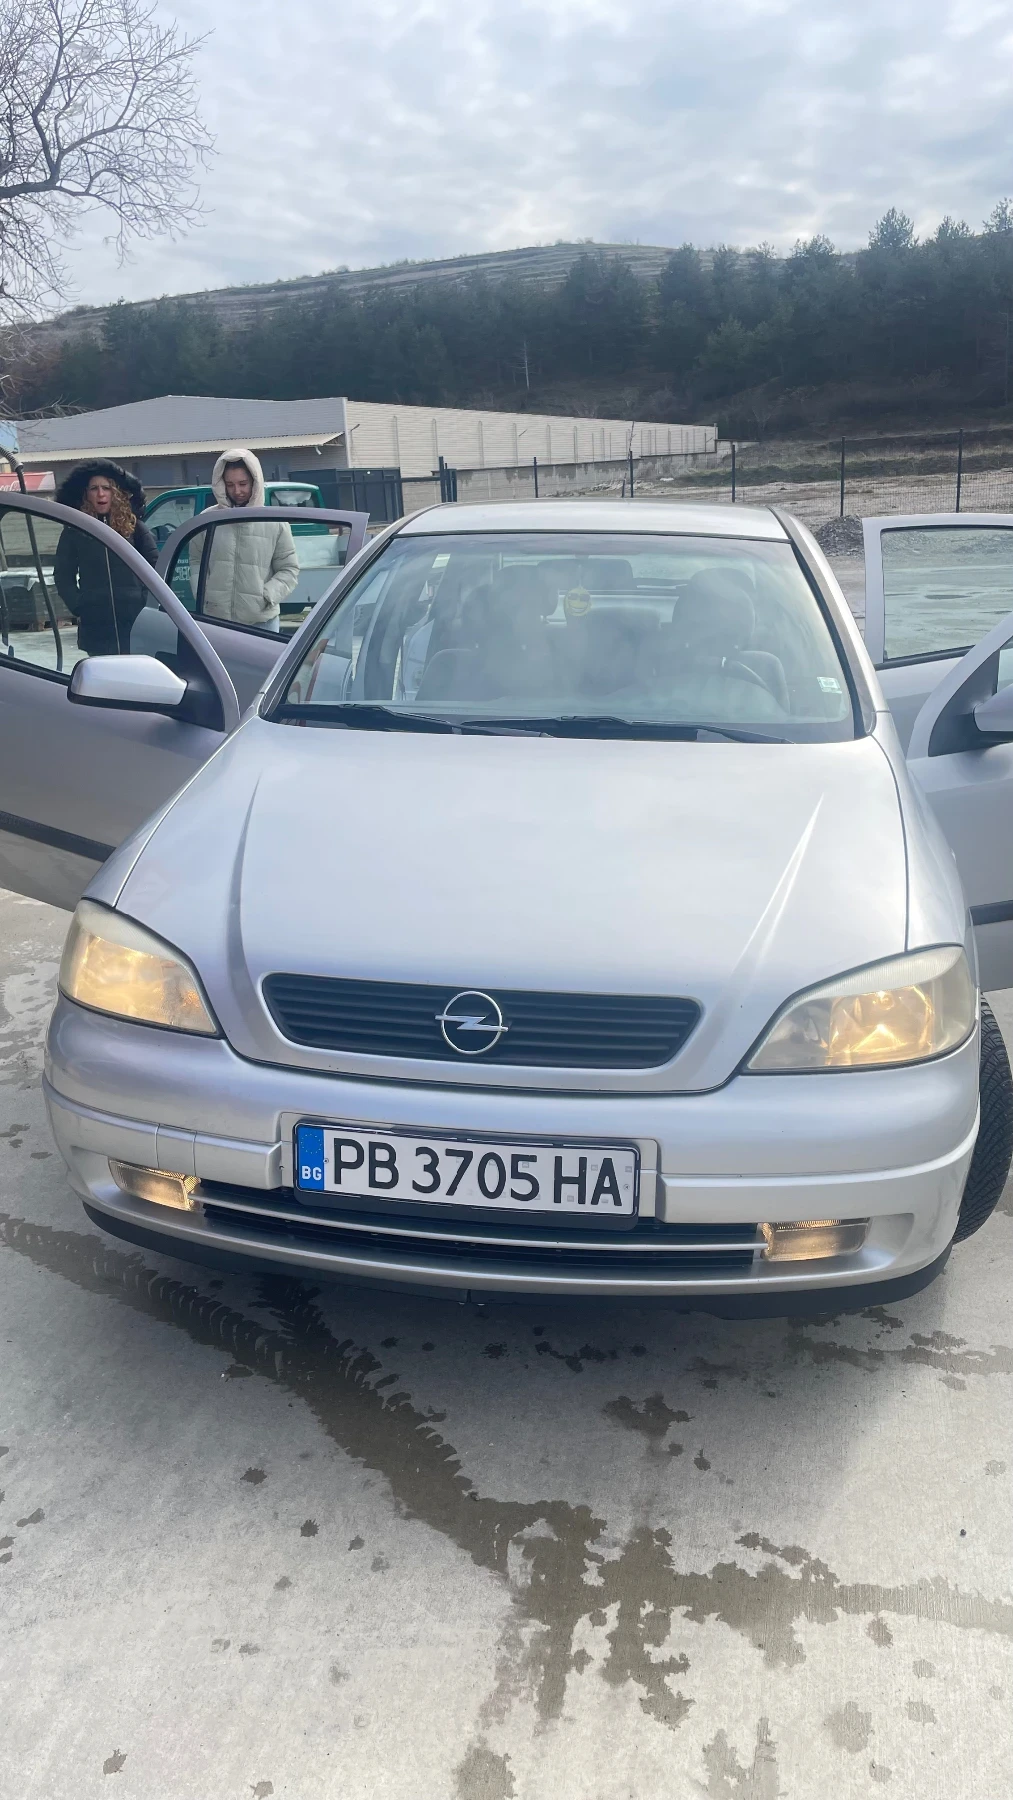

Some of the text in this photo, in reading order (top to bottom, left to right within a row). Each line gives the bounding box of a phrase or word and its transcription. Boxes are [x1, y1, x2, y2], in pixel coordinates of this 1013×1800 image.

[301, 1165, 322, 1181] BG
[333, 1137, 623, 1207] PB 3705 HA
